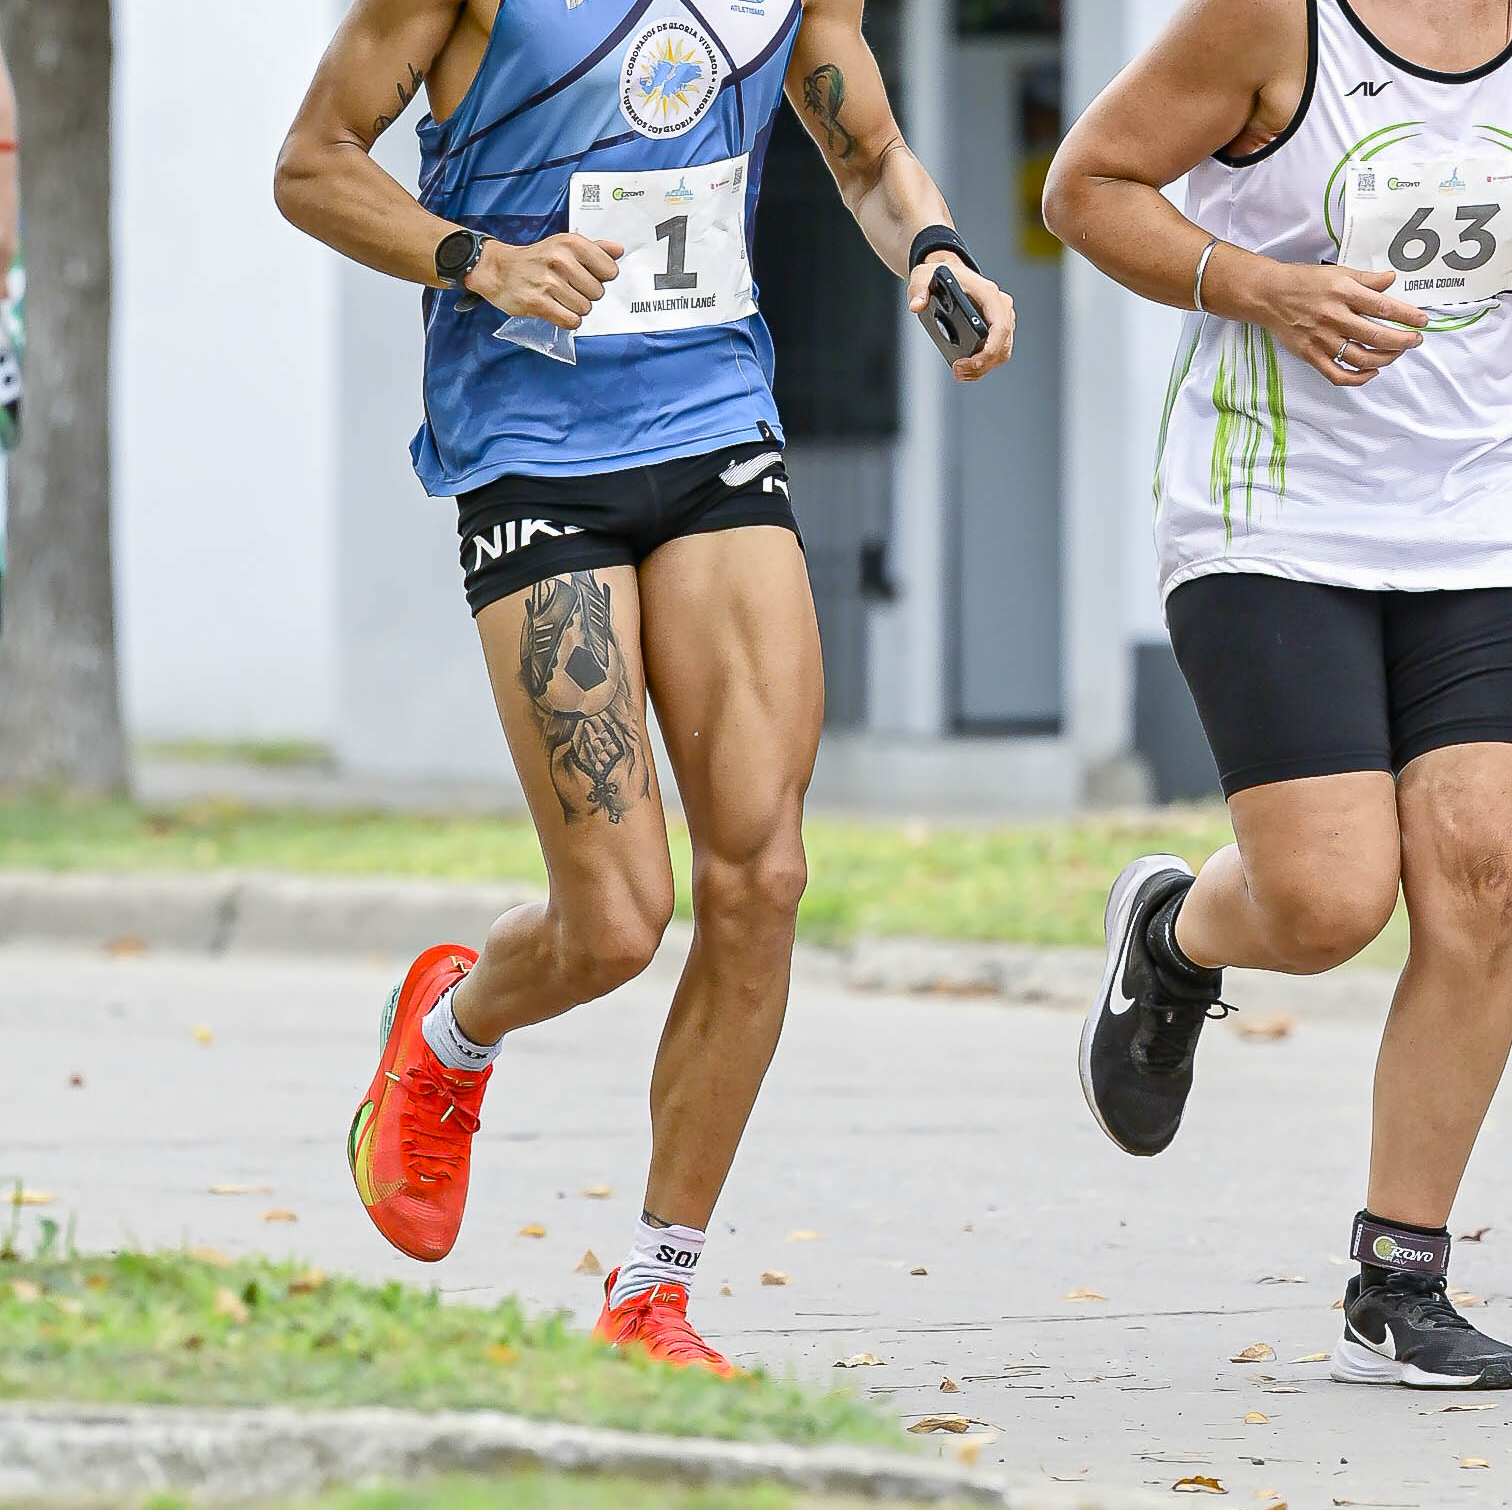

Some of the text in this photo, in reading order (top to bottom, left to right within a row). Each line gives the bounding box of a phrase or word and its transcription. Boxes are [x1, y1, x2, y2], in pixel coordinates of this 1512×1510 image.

[626, 27, 656, 76] CORONADOS
[656, 23, 668, 33] DE
[668, 22, 698, 38] GLORIA
[663, 116, 694, 132] GLORIA
[653, 215, 698, 291] 1
[1387, 203, 1501, 273] 63
[1404, 277, 1465, 292] LORENA CODINA
[630, 293, 717, 314] JUAN VALENTÍN LANGÉ
